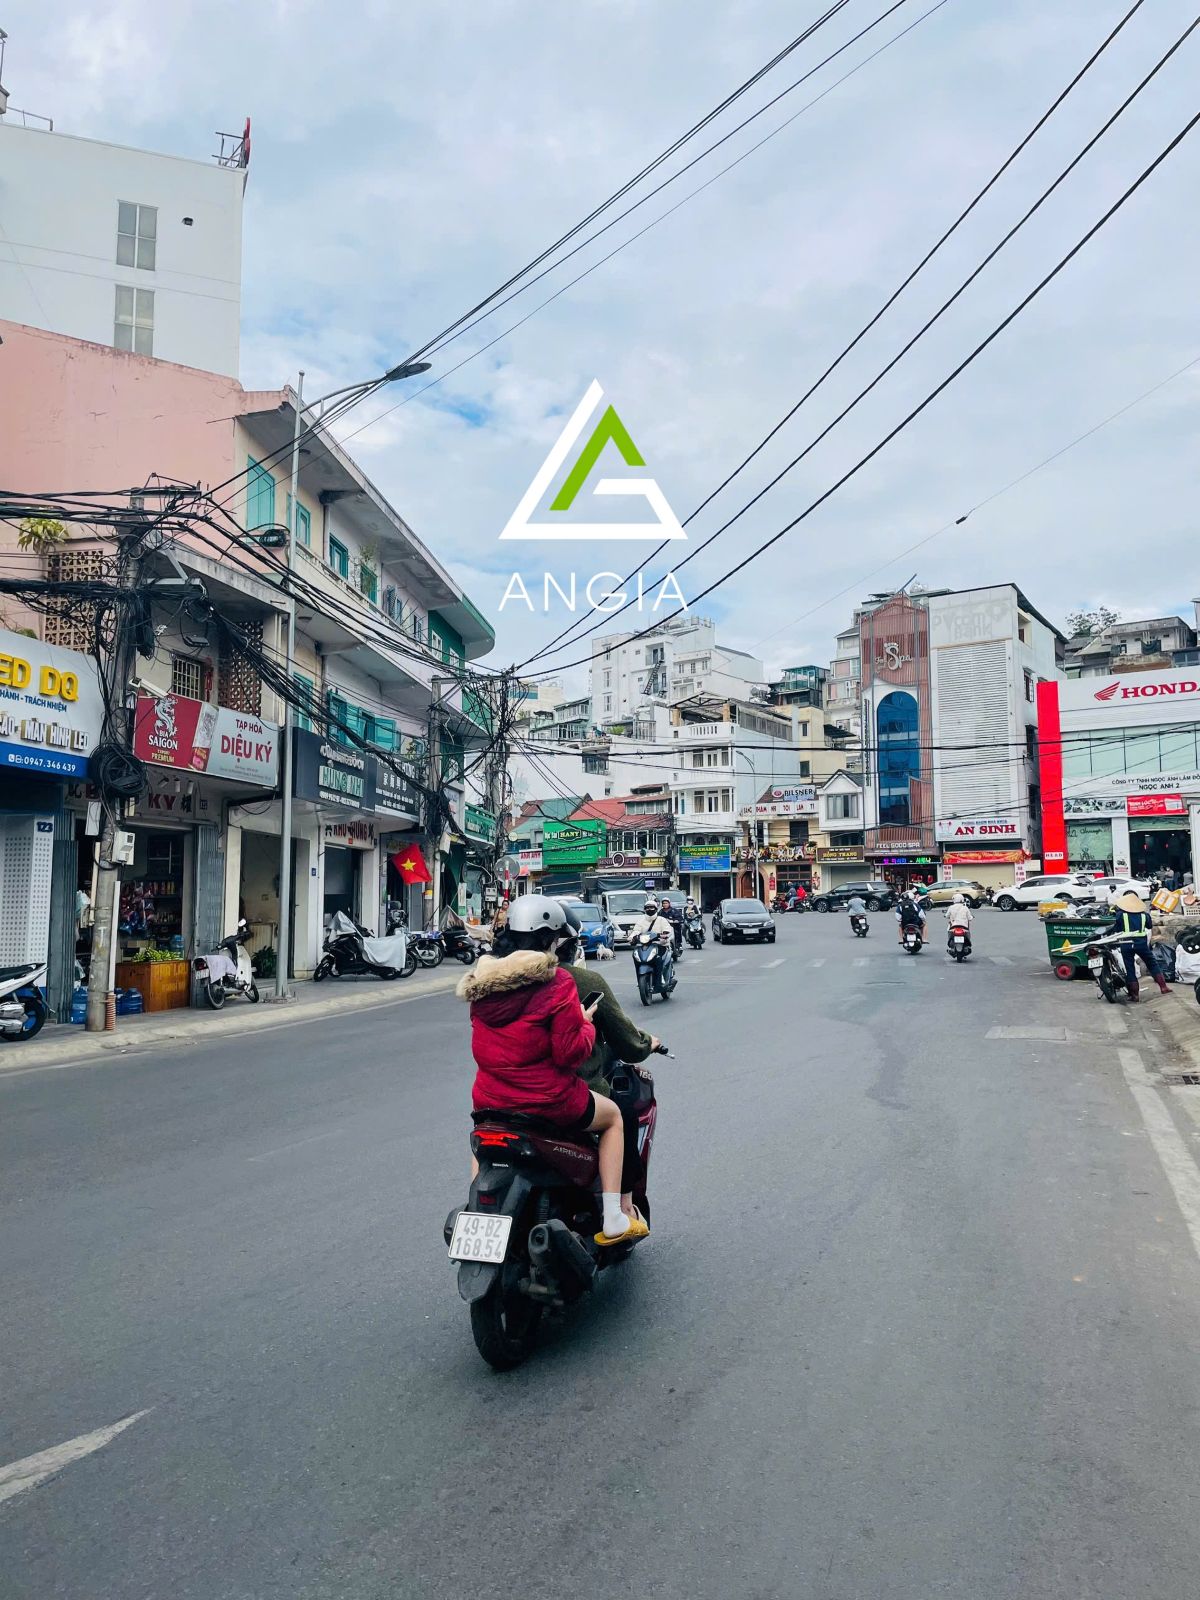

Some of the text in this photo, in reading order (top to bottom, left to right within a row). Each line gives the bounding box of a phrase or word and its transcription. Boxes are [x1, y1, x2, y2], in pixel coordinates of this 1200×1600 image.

[39, 665, 79, 702] DQ
[1121, 681, 1200, 699] HOND
[24, 694, 46, 708] TRÁCH
[47, 700, 67, 713] NHIỆM
[148, 734, 178, 750] SAIGON
[221, 733, 273, 763] DIỆU KÝ
[62, 762, 76, 772] 439
[1138, 783, 1158, 791] NGỌC
[955, 824, 1016, 836] AN SINH
[463, 1217, 503, 1238] 49-B2
